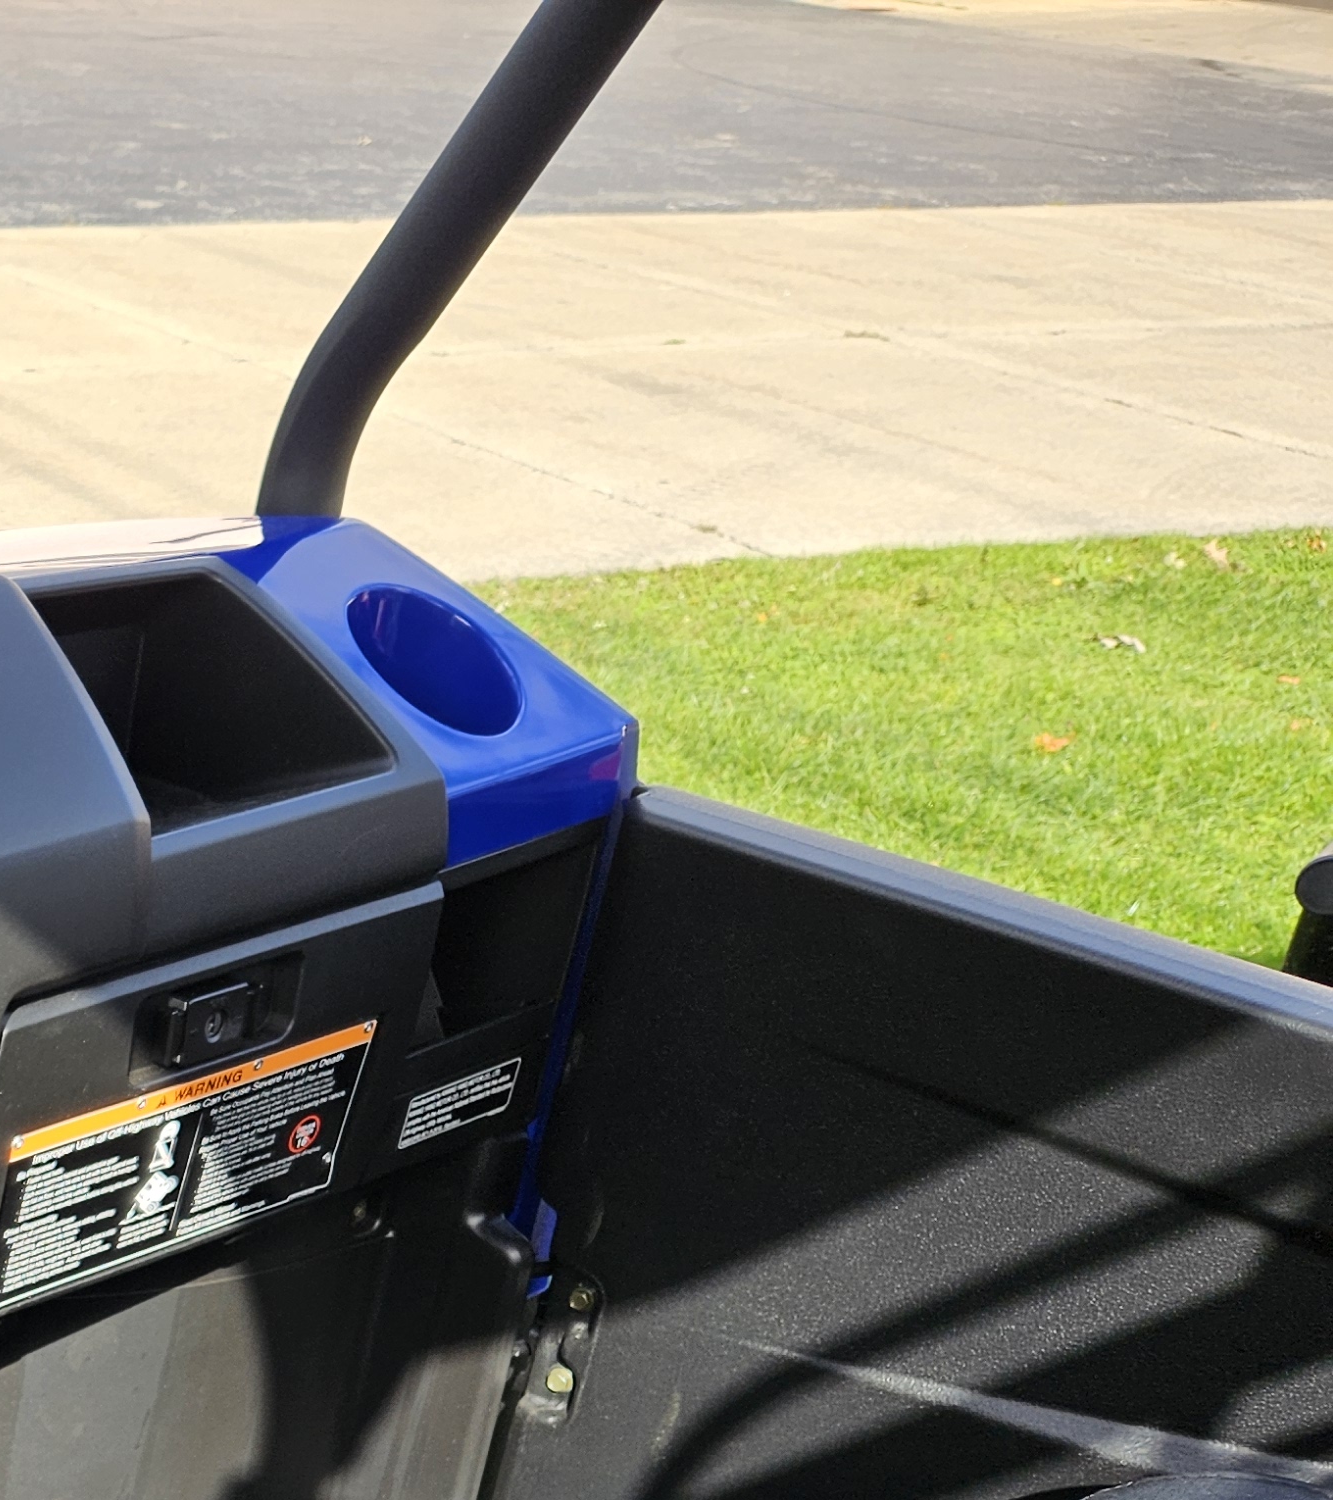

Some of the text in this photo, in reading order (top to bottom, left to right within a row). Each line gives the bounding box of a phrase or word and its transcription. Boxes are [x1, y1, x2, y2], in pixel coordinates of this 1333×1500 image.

[32, 1143, 75, 1166] Improper
[76, 1134, 93, 1151] Use
[96, 1133, 106, 1144] of
[203, 1094, 220, 1108] Can
[223, 1086, 250, 1101] Cause
[252, 1074, 282, 1091] Severe
[284, 1066, 307, 1082] Injury
[309, 1063, 318, 1072] or
[319, 1052, 345, 1068] Death
[174, 1071, 242, 1101] WARNING
